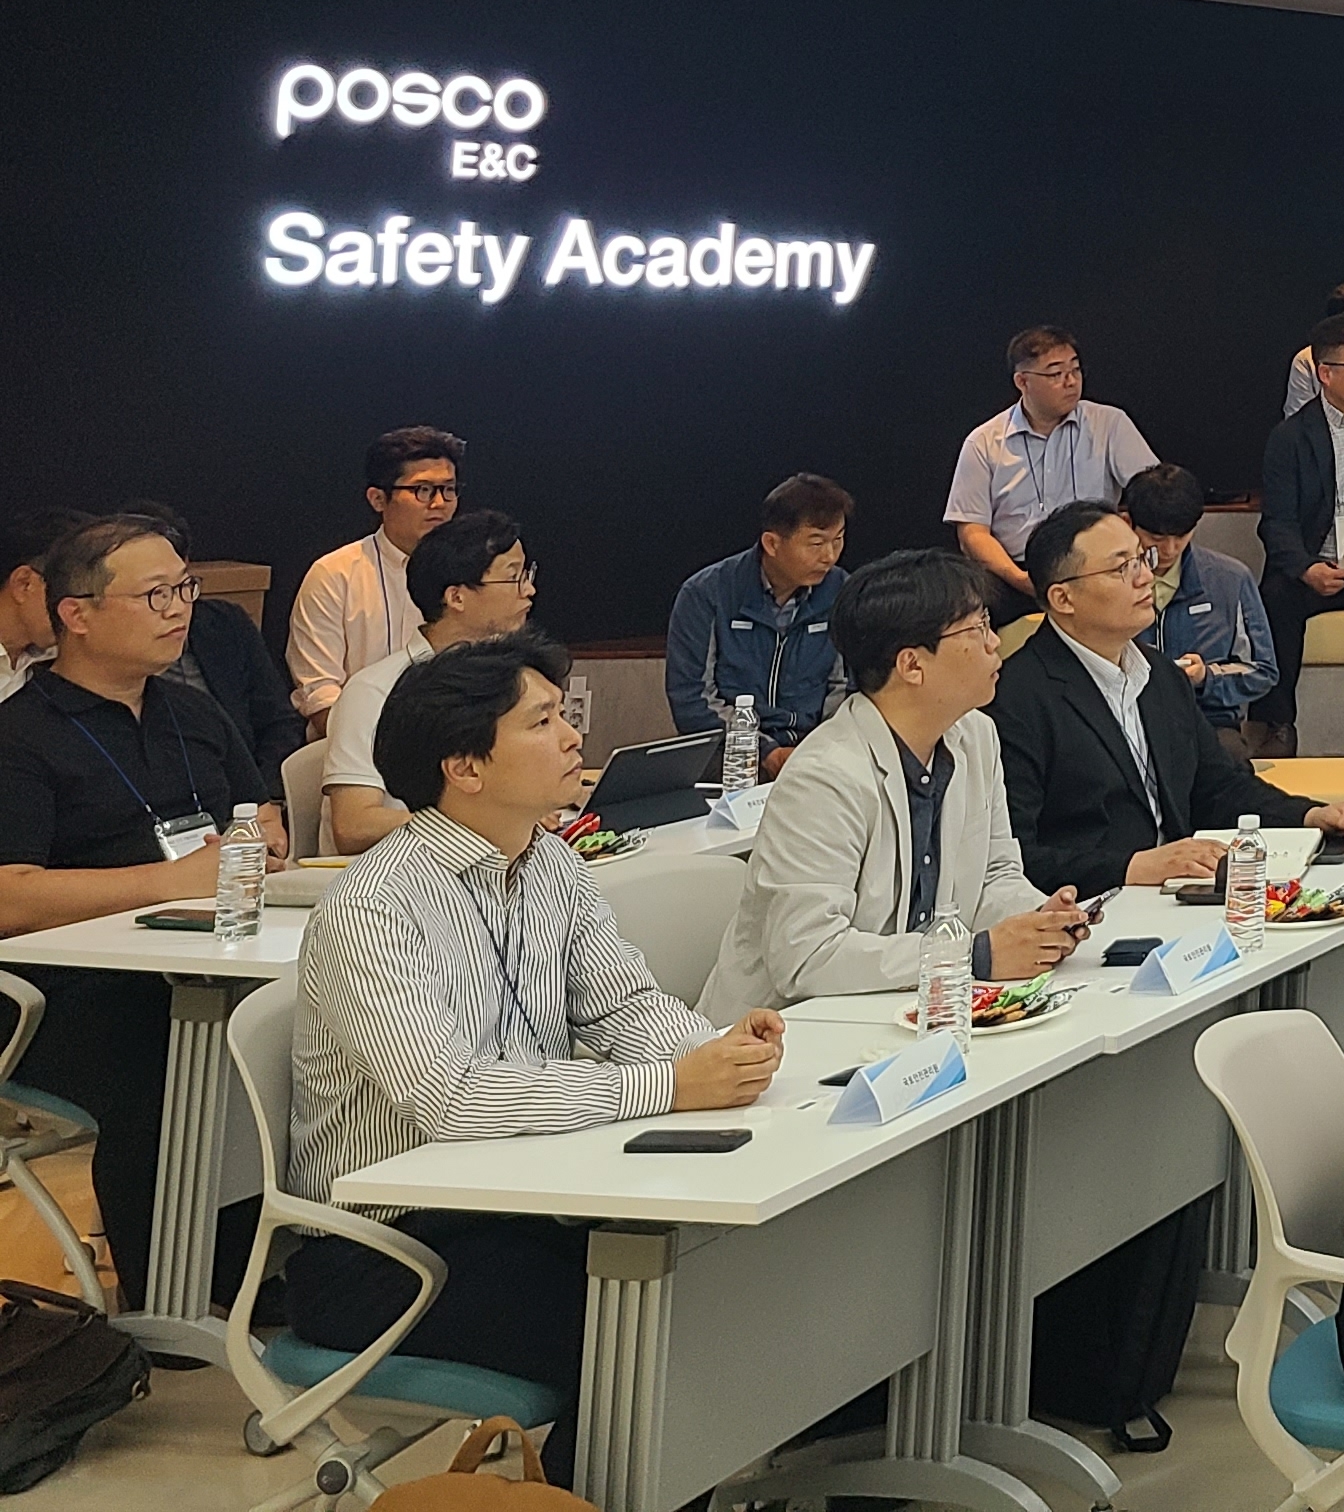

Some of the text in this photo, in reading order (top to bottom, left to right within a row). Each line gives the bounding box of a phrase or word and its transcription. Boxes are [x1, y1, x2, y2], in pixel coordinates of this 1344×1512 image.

[276, 64, 546, 137] posco
[450, 141, 540, 182] E&C
[264, 211, 876, 306] Safety Academy
